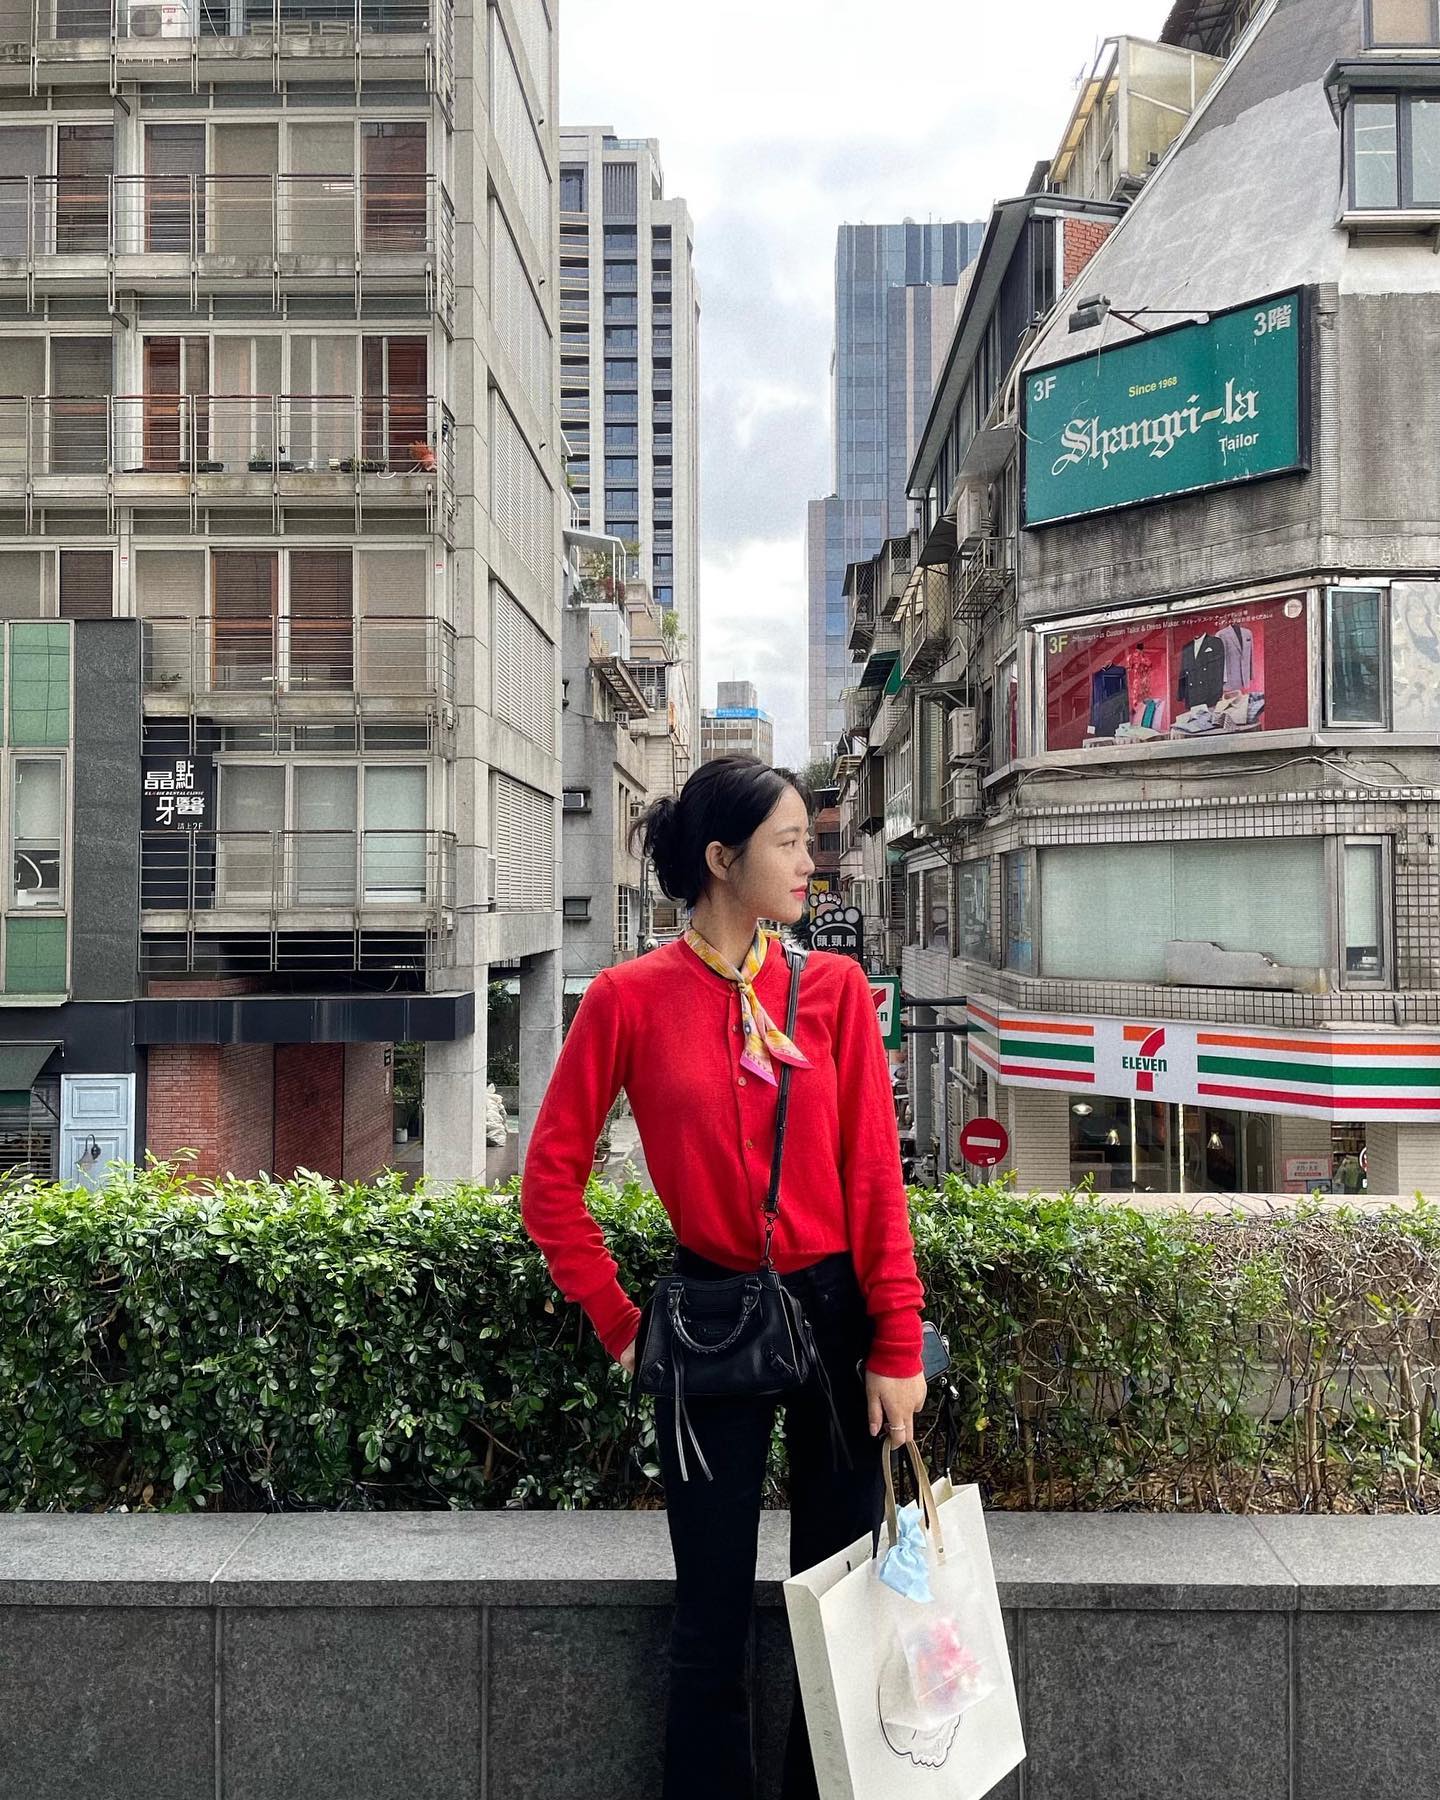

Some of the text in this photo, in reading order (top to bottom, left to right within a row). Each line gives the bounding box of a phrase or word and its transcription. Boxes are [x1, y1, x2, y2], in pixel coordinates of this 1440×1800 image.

[1254, 304, 1292, 337] 3階
[1033, 375, 1057, 402] 3F
[1128, 376, 1178, 398] Since 1968
[1051, 377, 1260, 476] Shangri-la
[1219, 432, 1260, 452] Tailor
[1049, 634, 1068, 654] 3F
[144, 760, 195, 790] 晶點
[155, 796, 205, 825] 牙醫
